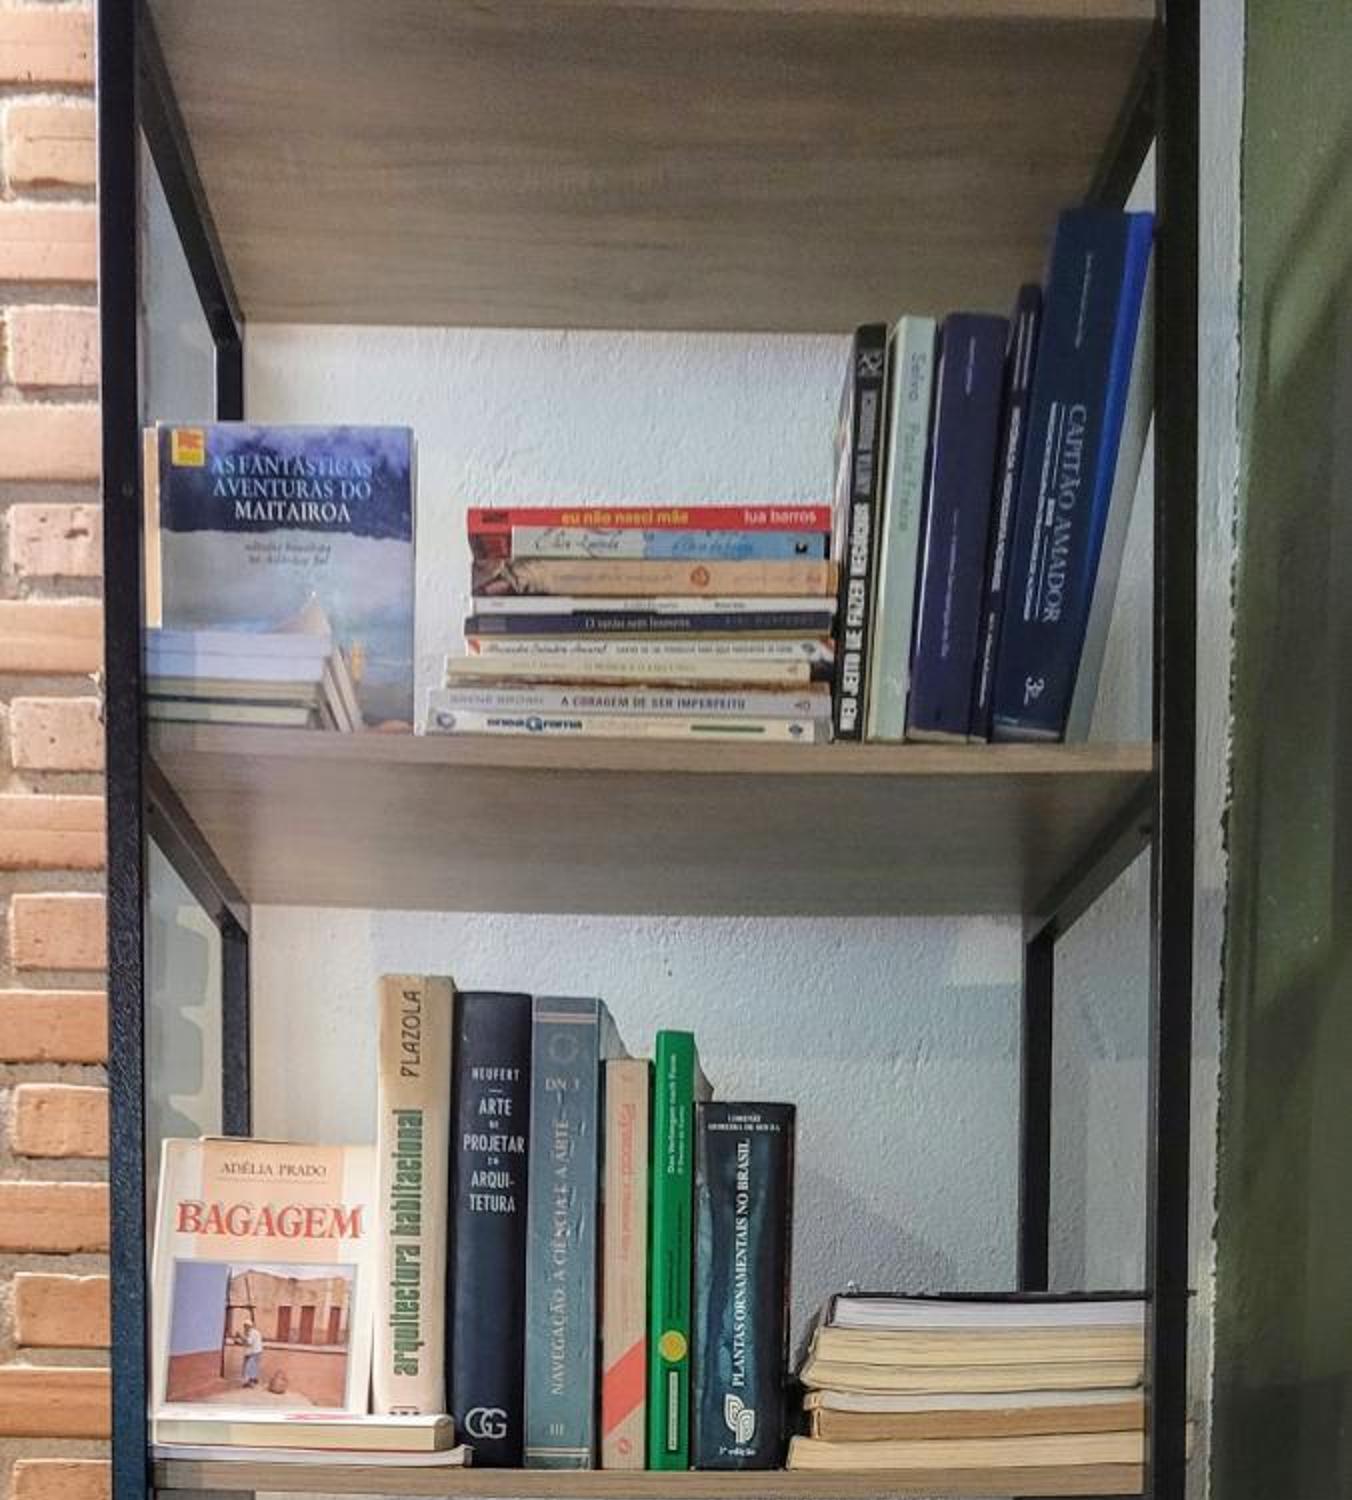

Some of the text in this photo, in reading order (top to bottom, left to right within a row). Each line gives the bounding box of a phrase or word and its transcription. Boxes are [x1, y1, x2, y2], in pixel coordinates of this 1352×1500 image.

[211, 455, 234, 475] AS
[213, 478, 372, 499] AVENTURAS DO
[235, 500, 351, 523] MAITAIROA
[561, 509, 817, 525] eu não nasci mãe lua barros
[1043, 404, 1087, 623] CAPITÃO AMADOR
[846, 579, 865, 627] FAZER
[845, 630, 863, 650] DE
[842, 653, 860, 696] JEITO
[561, 696, 569, 706] A
[573, 696, 629, 707] CORAGEM
[633, 697, 645, 708] DE
[652, 697, 672, 708] SER
[678, 698, 745, 710] IMPERFEITO
[839, 697, 857, 731] MEU
[400, 989, 422, 1078] PLAZOLA
[472, 1067, 520, 1081] NEUFERT
[479, 1097, 512, 1116] ARTE
[463, 1133, 525, 1153] PROJETAR
[554, 1119, 569, 1161] ARTE
[221, 1159, 327, 1177] ADÉLIA PRADO
[391, 1109, 423, 1237] habitacional
[471, 1170, 516, 1189] ARQUI-
[469, 1193, 516, 1212] TETURA
[175, 1201, 365, 1239] BAGAGEM
[731, 1138, 750, 1387] PLANTAS ORNAMENTAIS NO BRASIL
[391, 1245, 423, 1376] arquitectura
